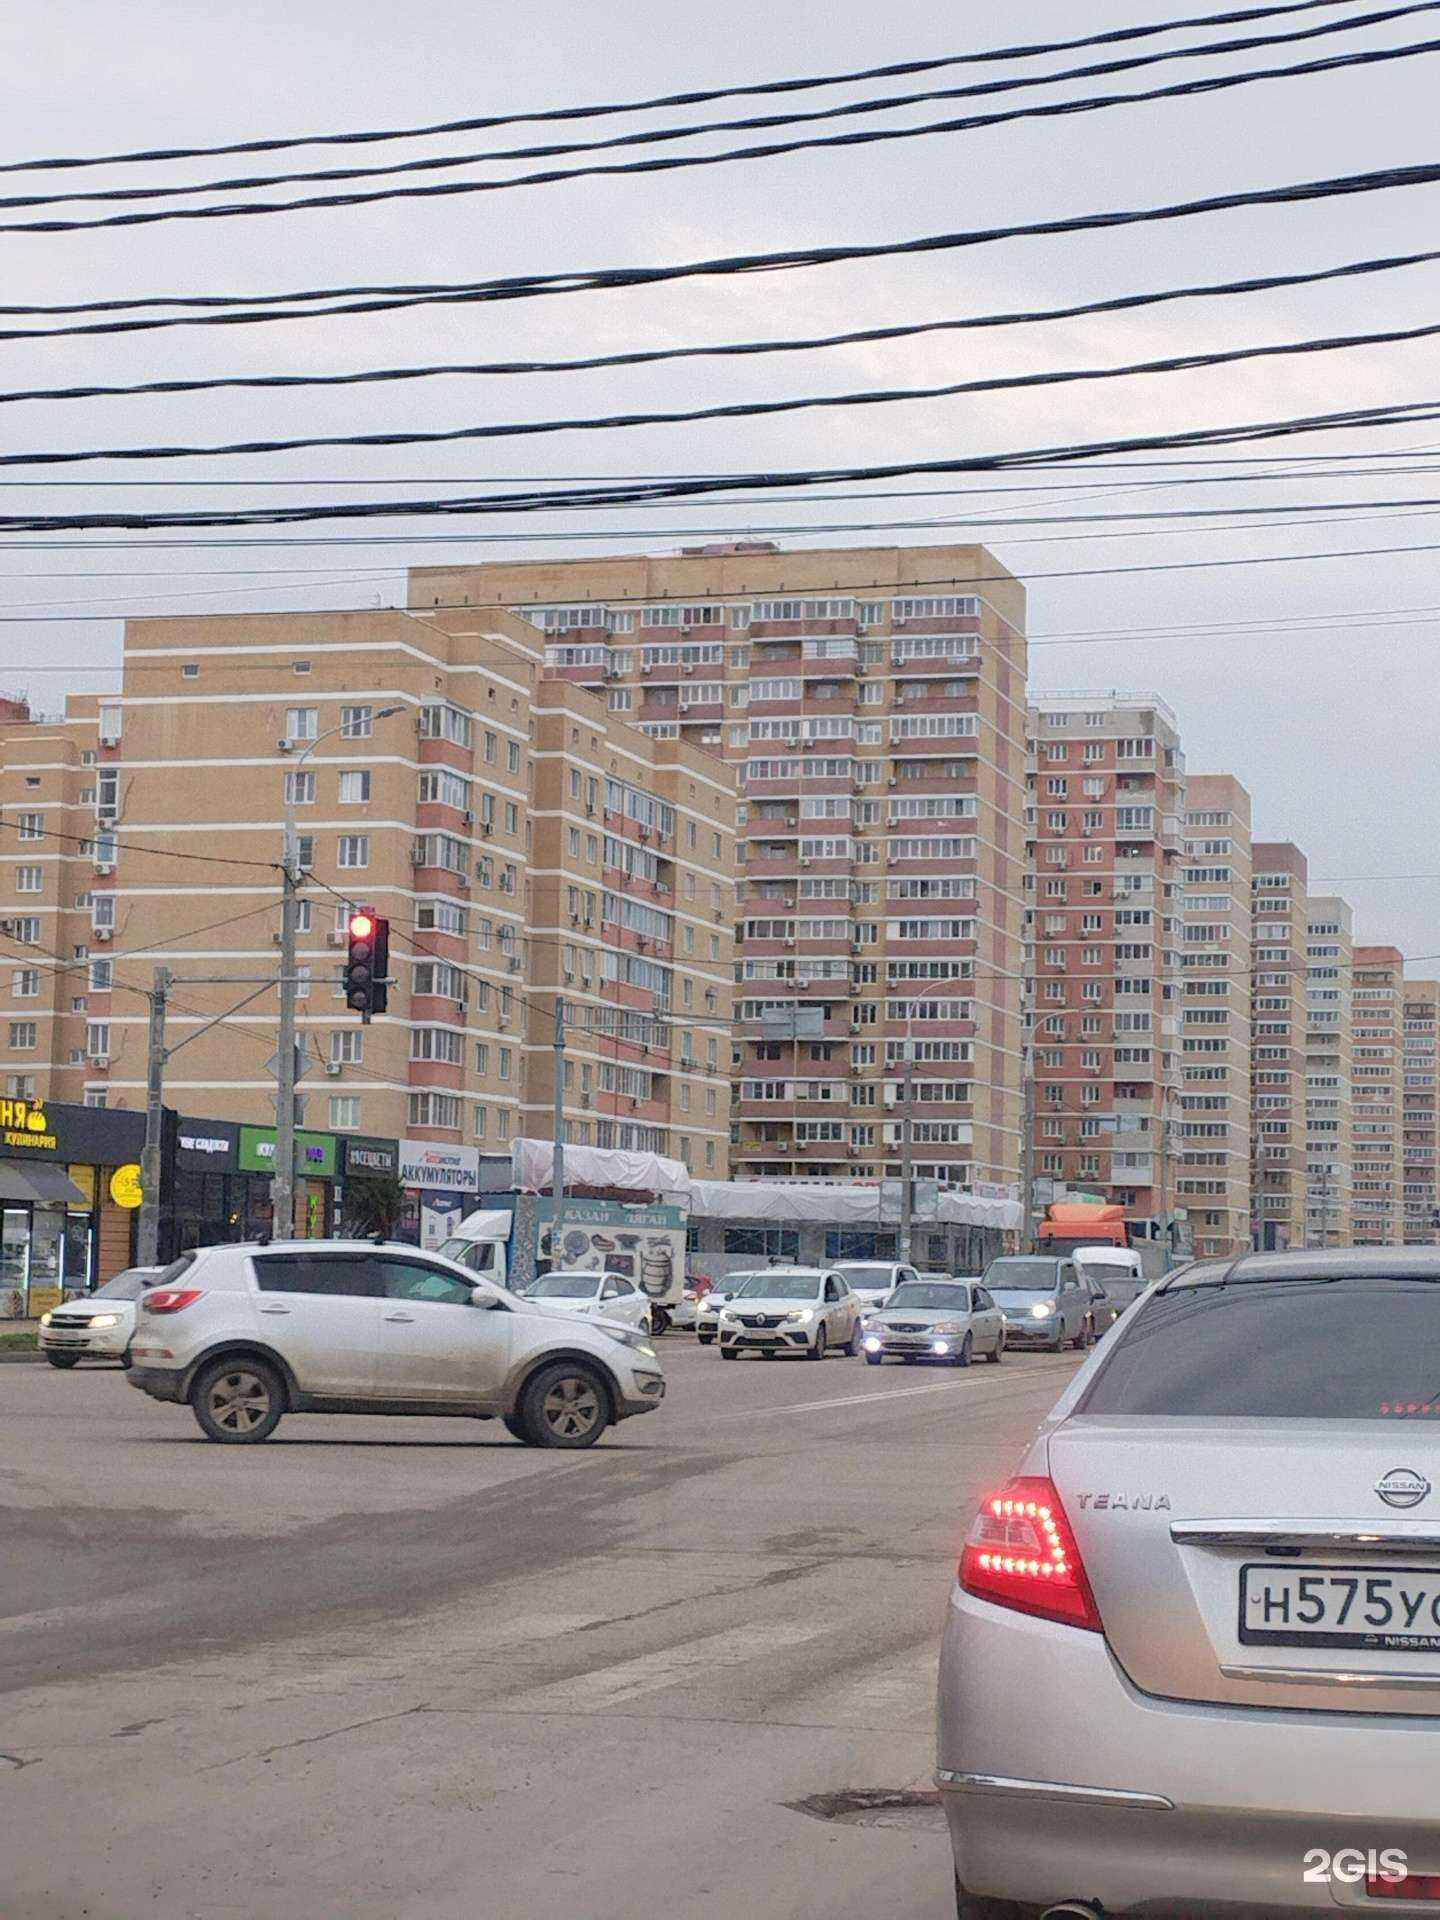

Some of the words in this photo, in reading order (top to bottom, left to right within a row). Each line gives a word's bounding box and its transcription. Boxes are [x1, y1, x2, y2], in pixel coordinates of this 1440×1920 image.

[4, 1131, 57, 1150] КУЛИНАРИЯ
[401, 1163, 476, 1186] АККУМУЛЯТОРЫ
[1379, 1480, 1425, 1490] NISSAN
[1077, 1493, 1172, 1511] TEANA
[1385, 1635, 1440, 1647] NISSAN
